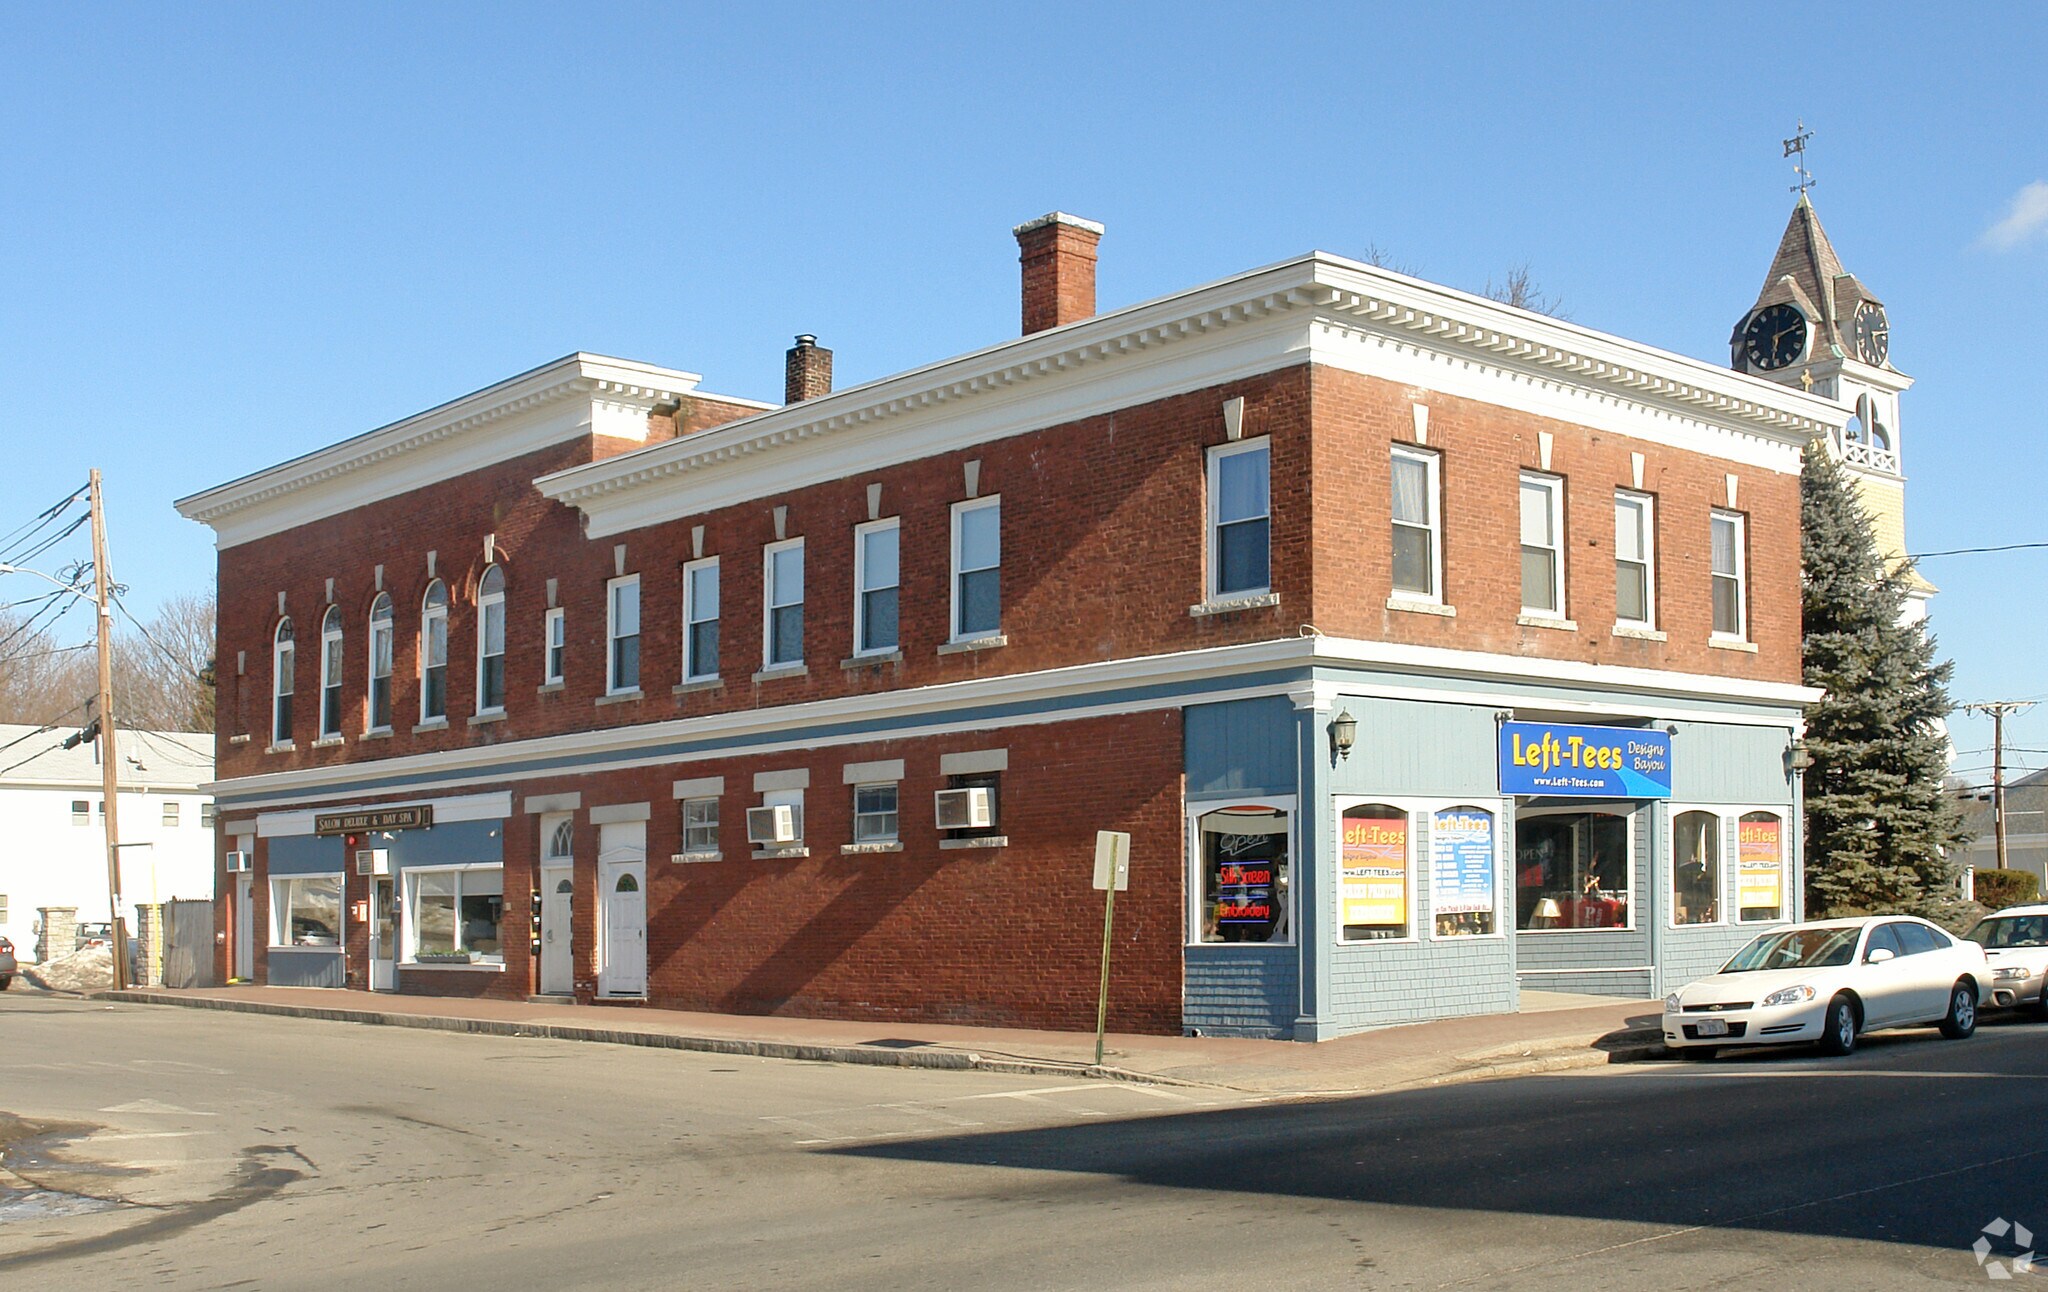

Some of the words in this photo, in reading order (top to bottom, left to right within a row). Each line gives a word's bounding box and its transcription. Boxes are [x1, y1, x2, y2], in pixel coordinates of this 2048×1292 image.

[1513, 732, 1623, 773] Left-Tees
[1628, 741, 1666, 758] Designs
[1634, 757, 1666, 773] Bayou
[1533, 776, 1605, 788] www.Left-Tees.com
[372, 814, 378, 825] &
[383, 813, 397, 825] DAY
[399, 811, 413, 824] SPA
[1220, 834, 1268, 851] Open
[1343, 824, 1405, 846] eft-Tees
[1220, 867, 1237, 884] Silk
[1239, 866, 1271, 885] Screen
[1219, 903, 1270, 919] Embroidery
